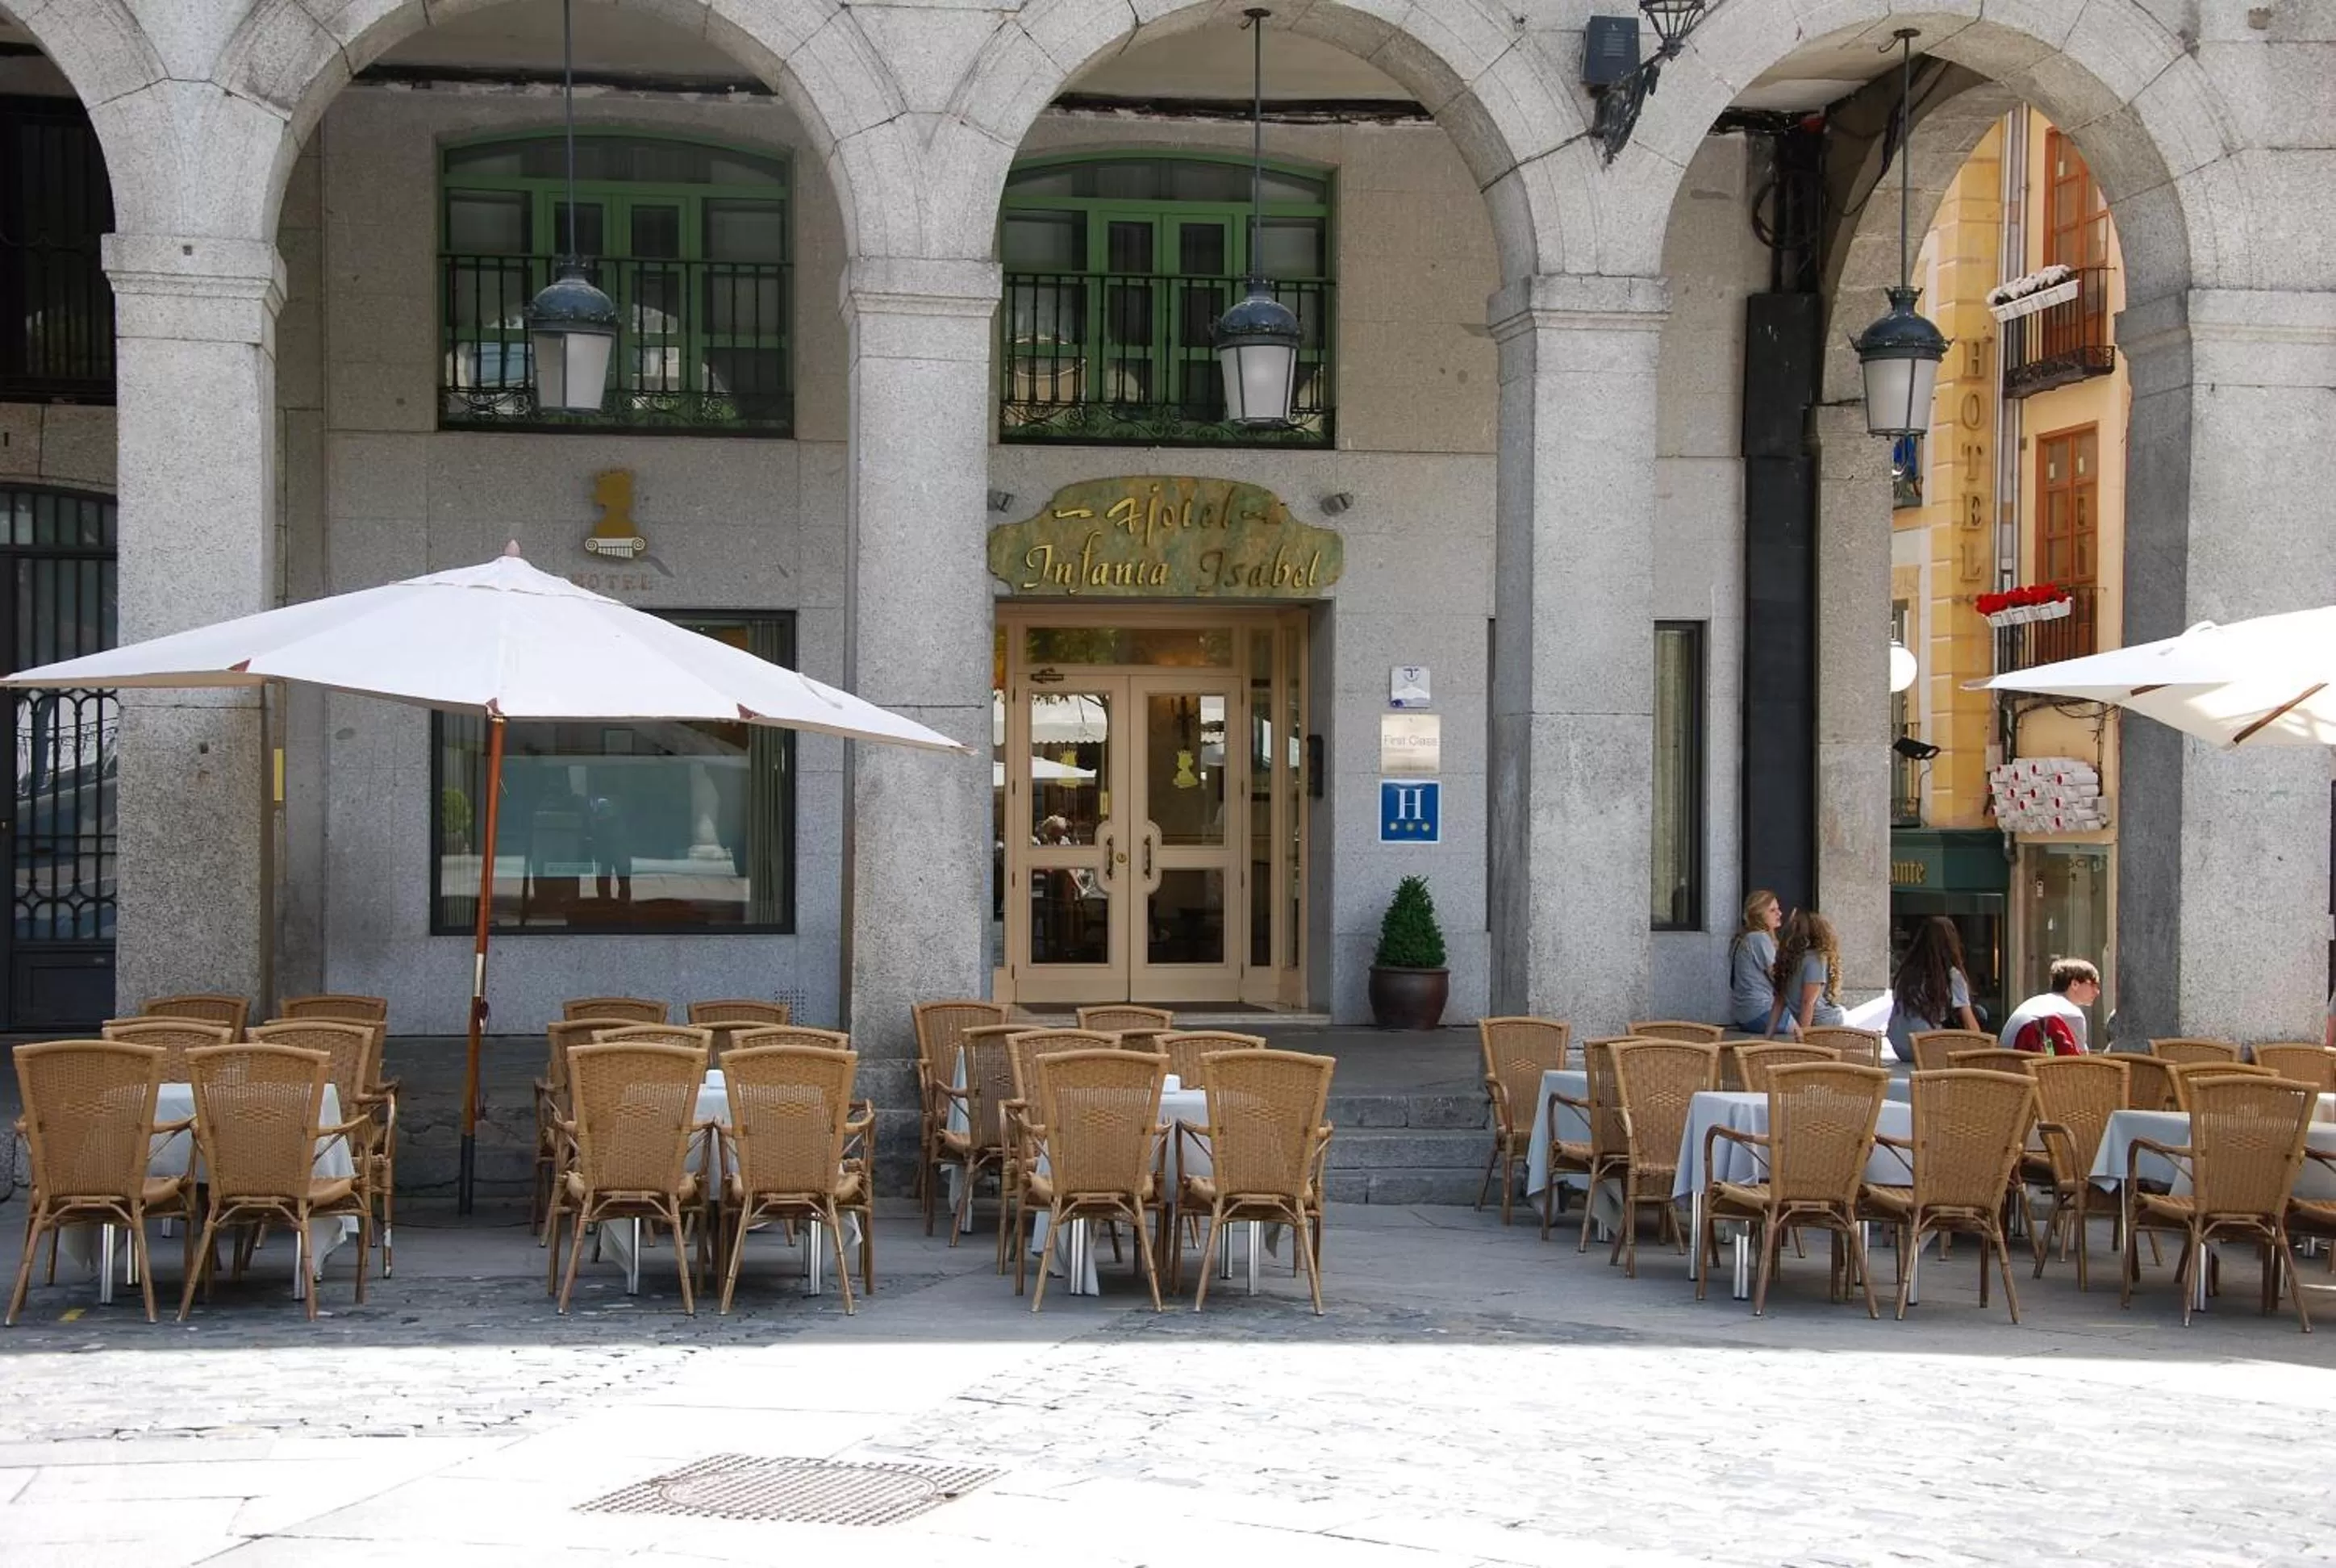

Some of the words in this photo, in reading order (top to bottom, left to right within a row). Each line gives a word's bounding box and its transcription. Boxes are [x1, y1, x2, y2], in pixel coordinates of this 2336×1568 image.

[1960, 340, 1986, 582] HOTEL
[1106, 484, 1237, 547] Hotel
[1022, 529, 1170, 596] Infanta
[1195, 543, 1321, 593] Isabel
[1396, 788, 1425, 820] H
